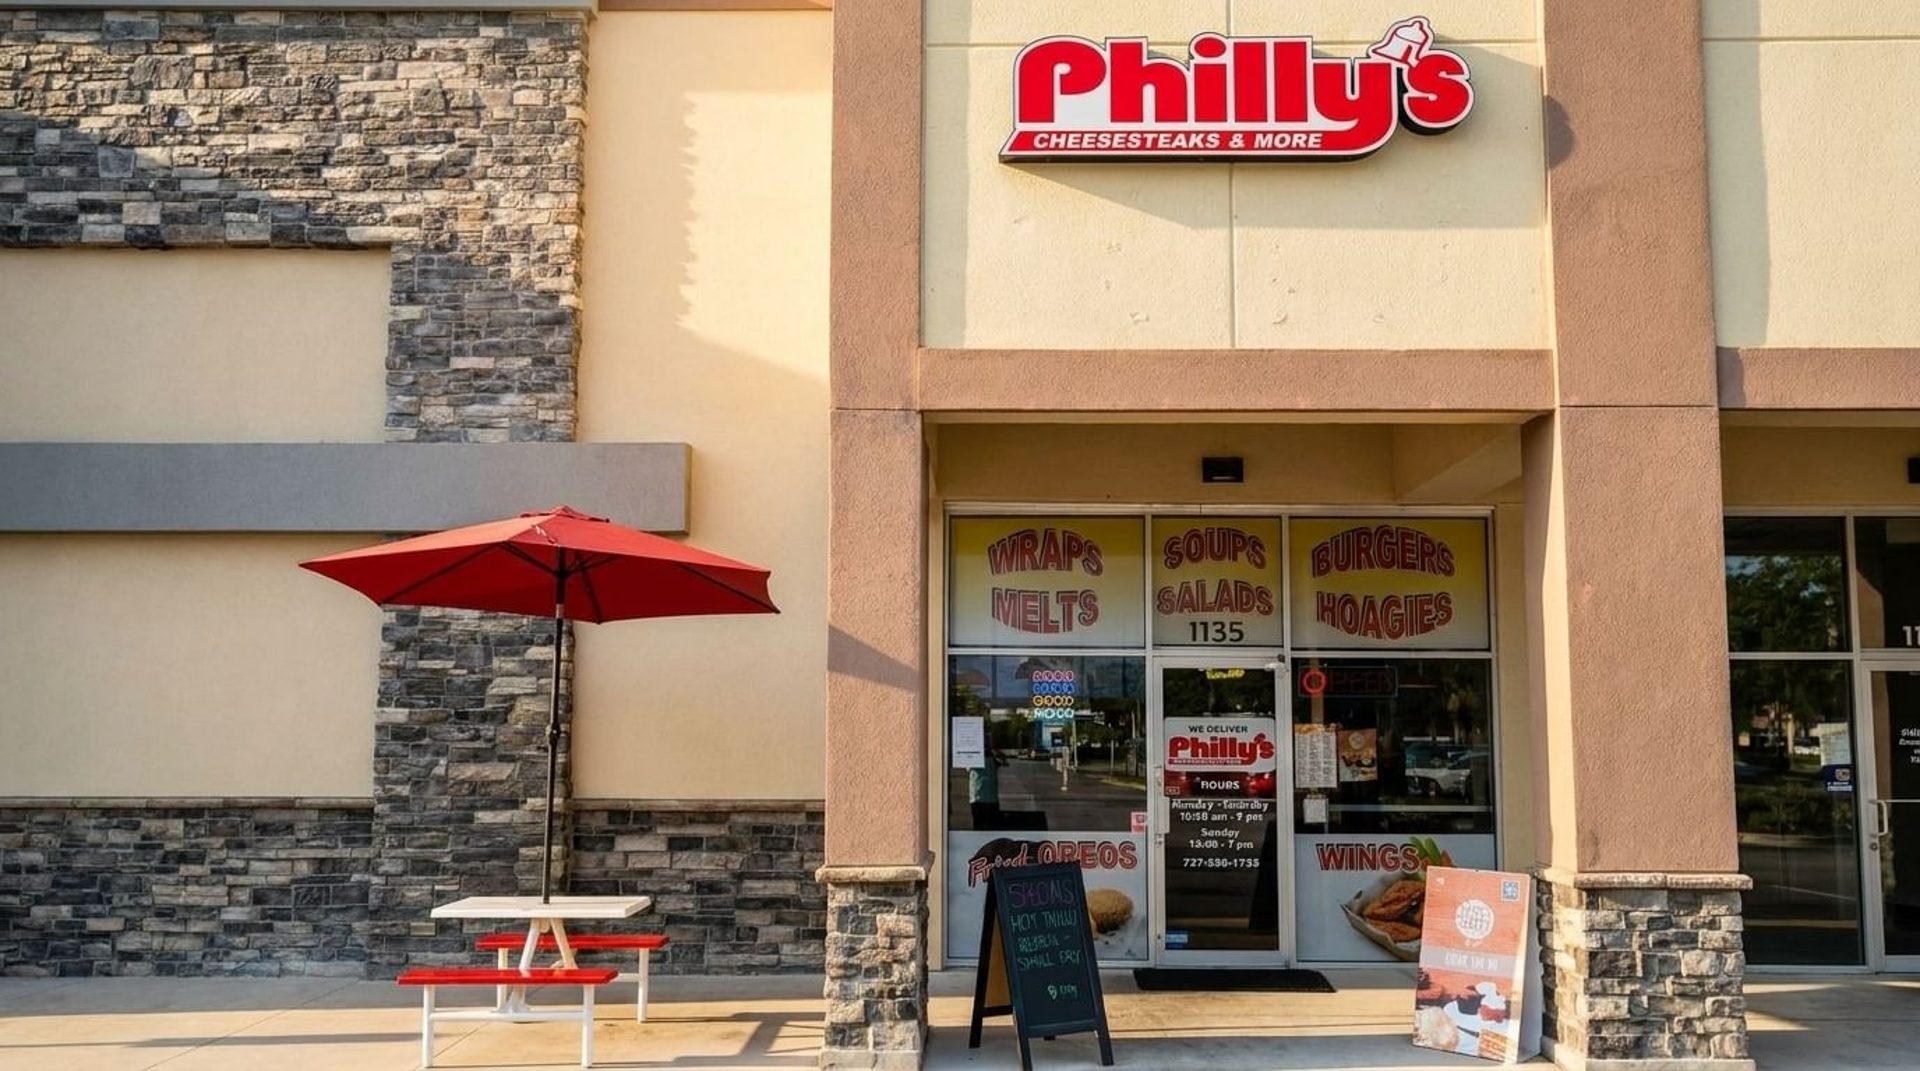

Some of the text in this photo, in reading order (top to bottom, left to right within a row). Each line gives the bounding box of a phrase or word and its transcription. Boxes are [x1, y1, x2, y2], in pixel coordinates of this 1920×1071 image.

[1016, 18, 1473, 128] Philly's
[1033, 133, 1322, 149] CHEESESTEAKS & MORE
[988, 528, 1103, 577] WRAPS
[1164, 527, 1267, 570] SOUPS
[1312, 525, 1455, 579] BURGERS
[991, 588, 1099, 634] MELTS
[1157, 579, 1275, 617] SALADS
[1316, 591, 1453, 640] HOAGIES
[1189, 621, 1244, 643] 1135
[1168, 733, 1275, 765] Philly's
[1188, 725, 1248, 733] WE DELIVER
[1316, 843, 1420, 872] WINGS
